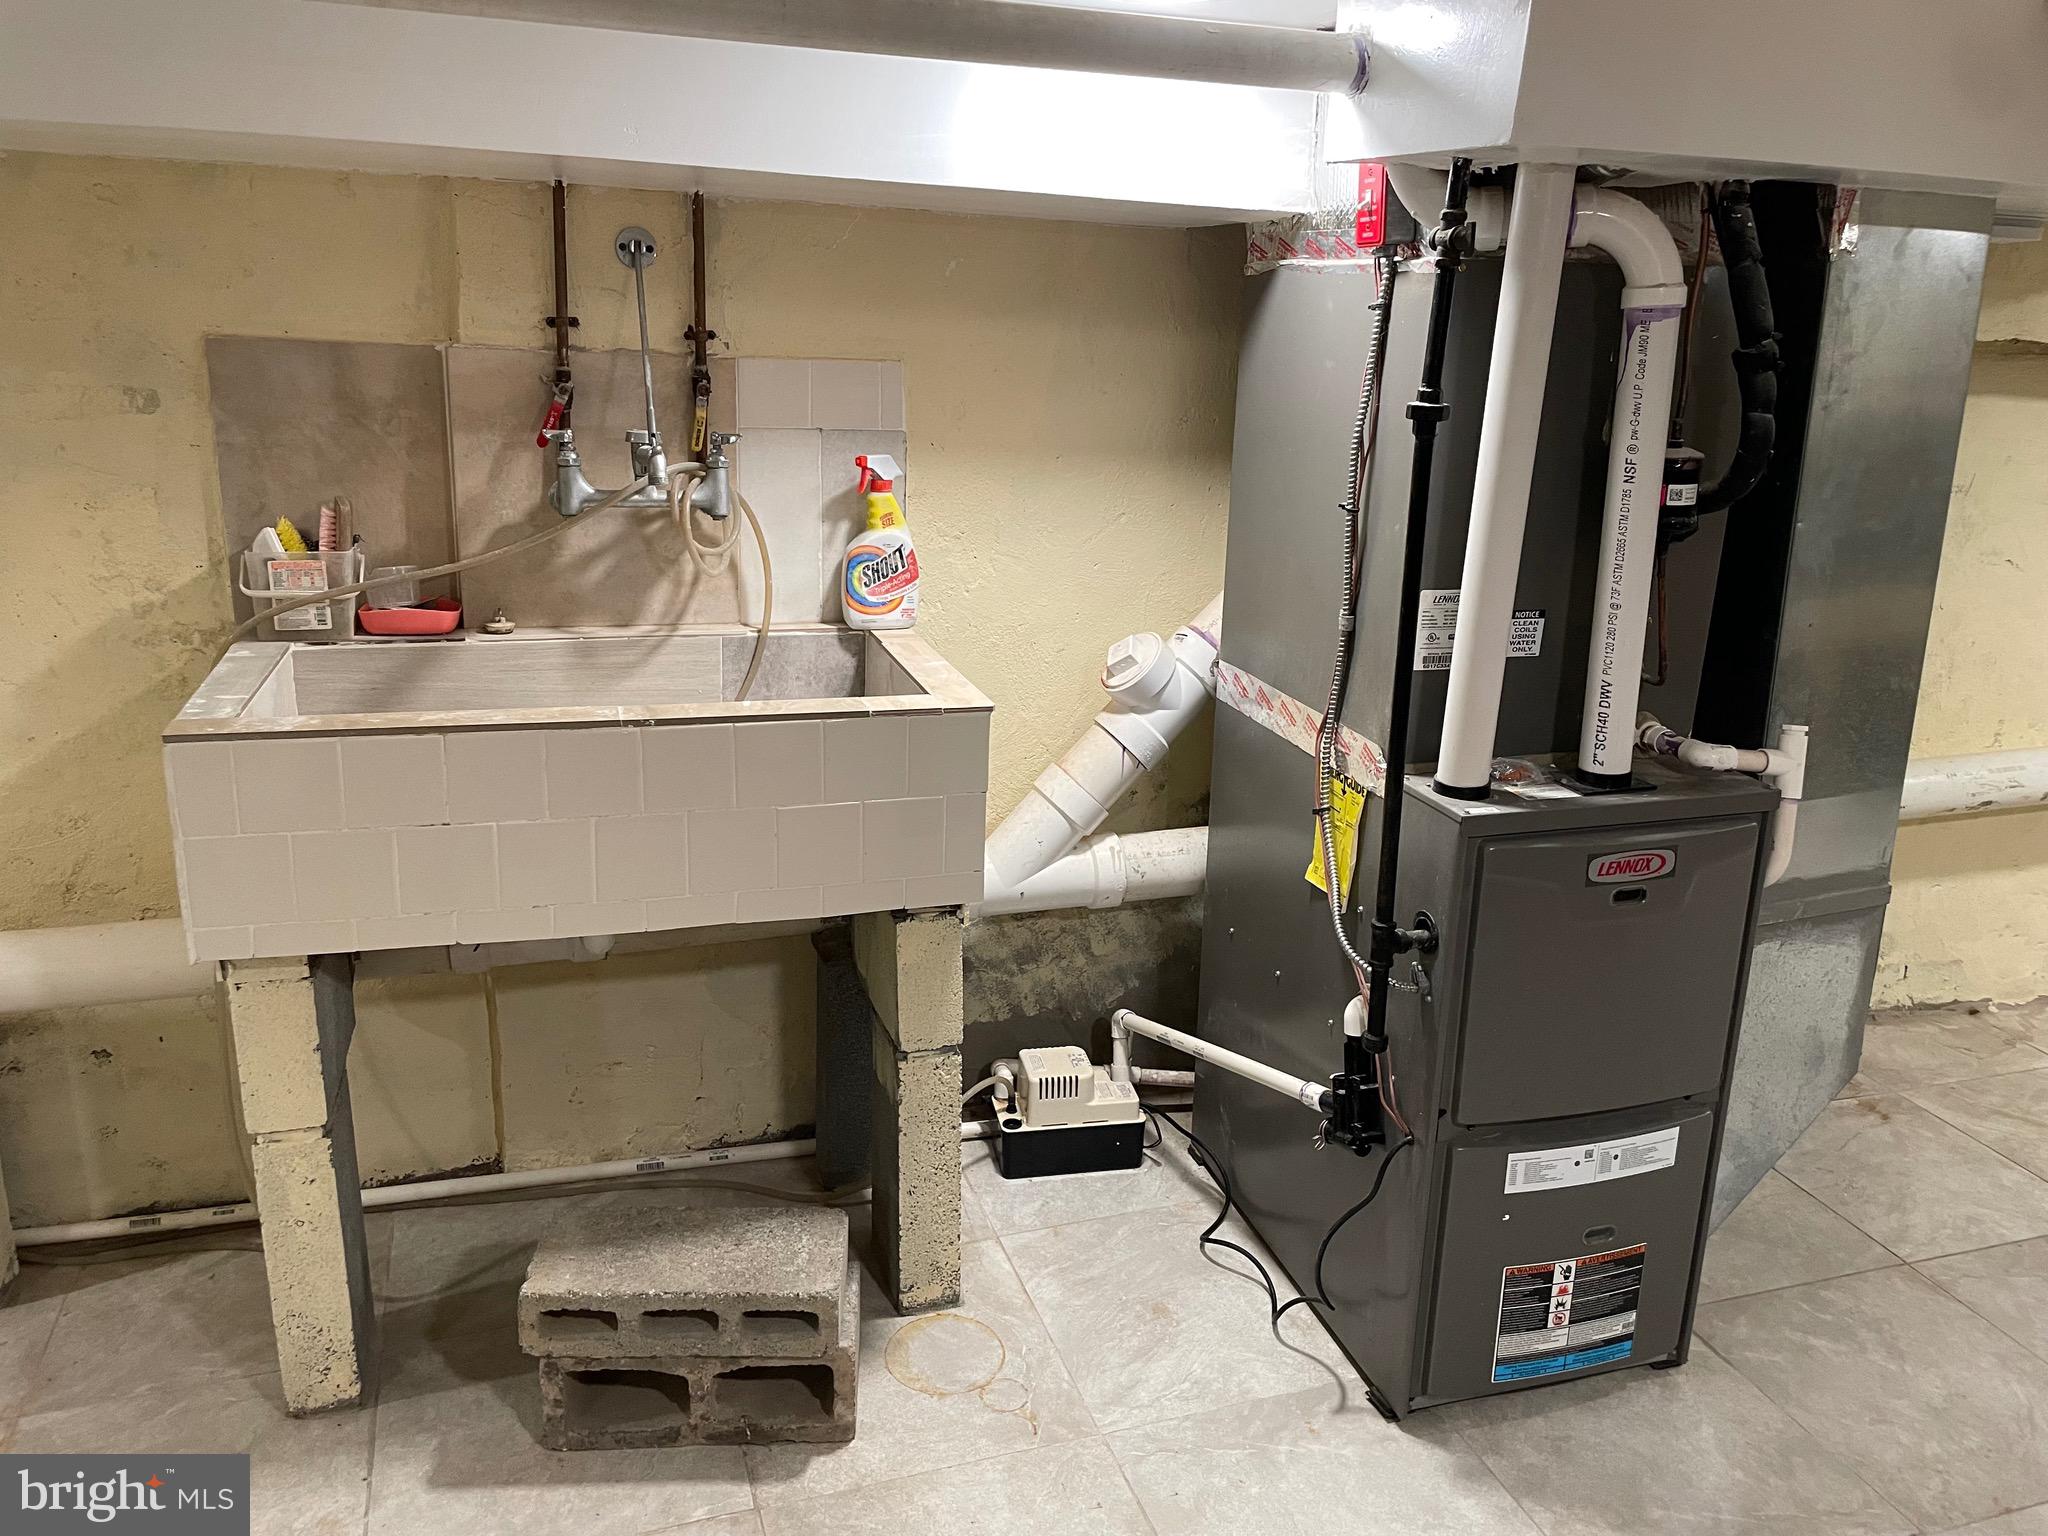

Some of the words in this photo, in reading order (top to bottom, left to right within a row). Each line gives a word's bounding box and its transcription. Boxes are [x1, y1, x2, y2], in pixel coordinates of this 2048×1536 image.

[1637, 334, 1650, 359] JM90
[1634, 358, 1647, 380] Code
[1623, 457, 1637, 484] NSF
[1619, 488, 1632, 513] D1785
[1617, 513, 1630, 538] ASTM
[1614, 537, 1627, 562] D2665
[861, 543, 908, 589] SHOUT
[1612, 562, 1624, 586] ASTM
[1432, 594, 1461, 604] LENNO
[1610, 586, 1621, 601] 73F
[1514, 610, 1540, 618] NOTICE
[1607, 612, 1618, 626] PSI
[1609, 602, 1622, 612] @
[1606, 626, 1617, 642] 280
[1602, 641, 1615, 676] PVC1120
[1598, 679, 1613, 710] DWV
[1594, 712, 1610, 751] SCH40
[1597, 856, 1655, 877] LENNOX
